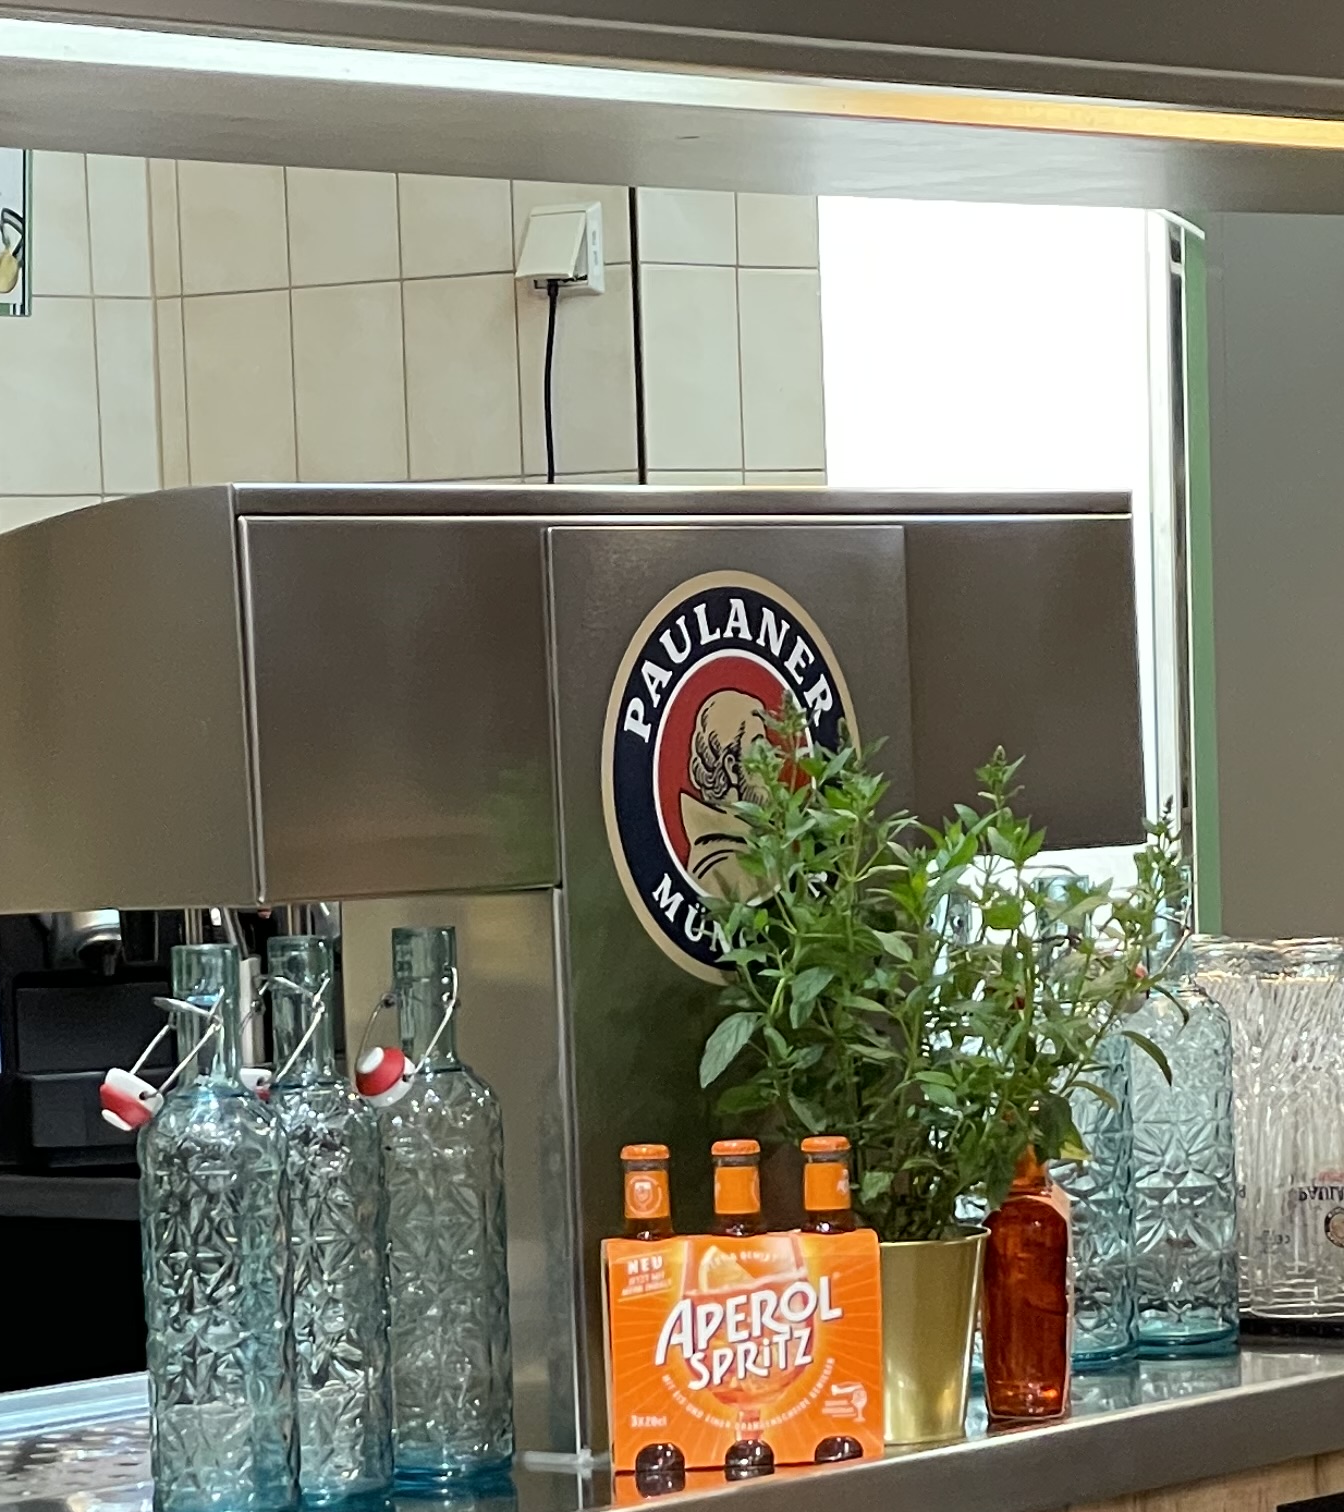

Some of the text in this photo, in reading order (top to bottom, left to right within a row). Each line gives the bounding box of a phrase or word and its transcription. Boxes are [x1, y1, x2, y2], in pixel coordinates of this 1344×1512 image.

[624, 598, 833, 743] PAULANER
[627, 1255, 663, 1275] NEU
[655, 1276, 843, 1367] APEROL
